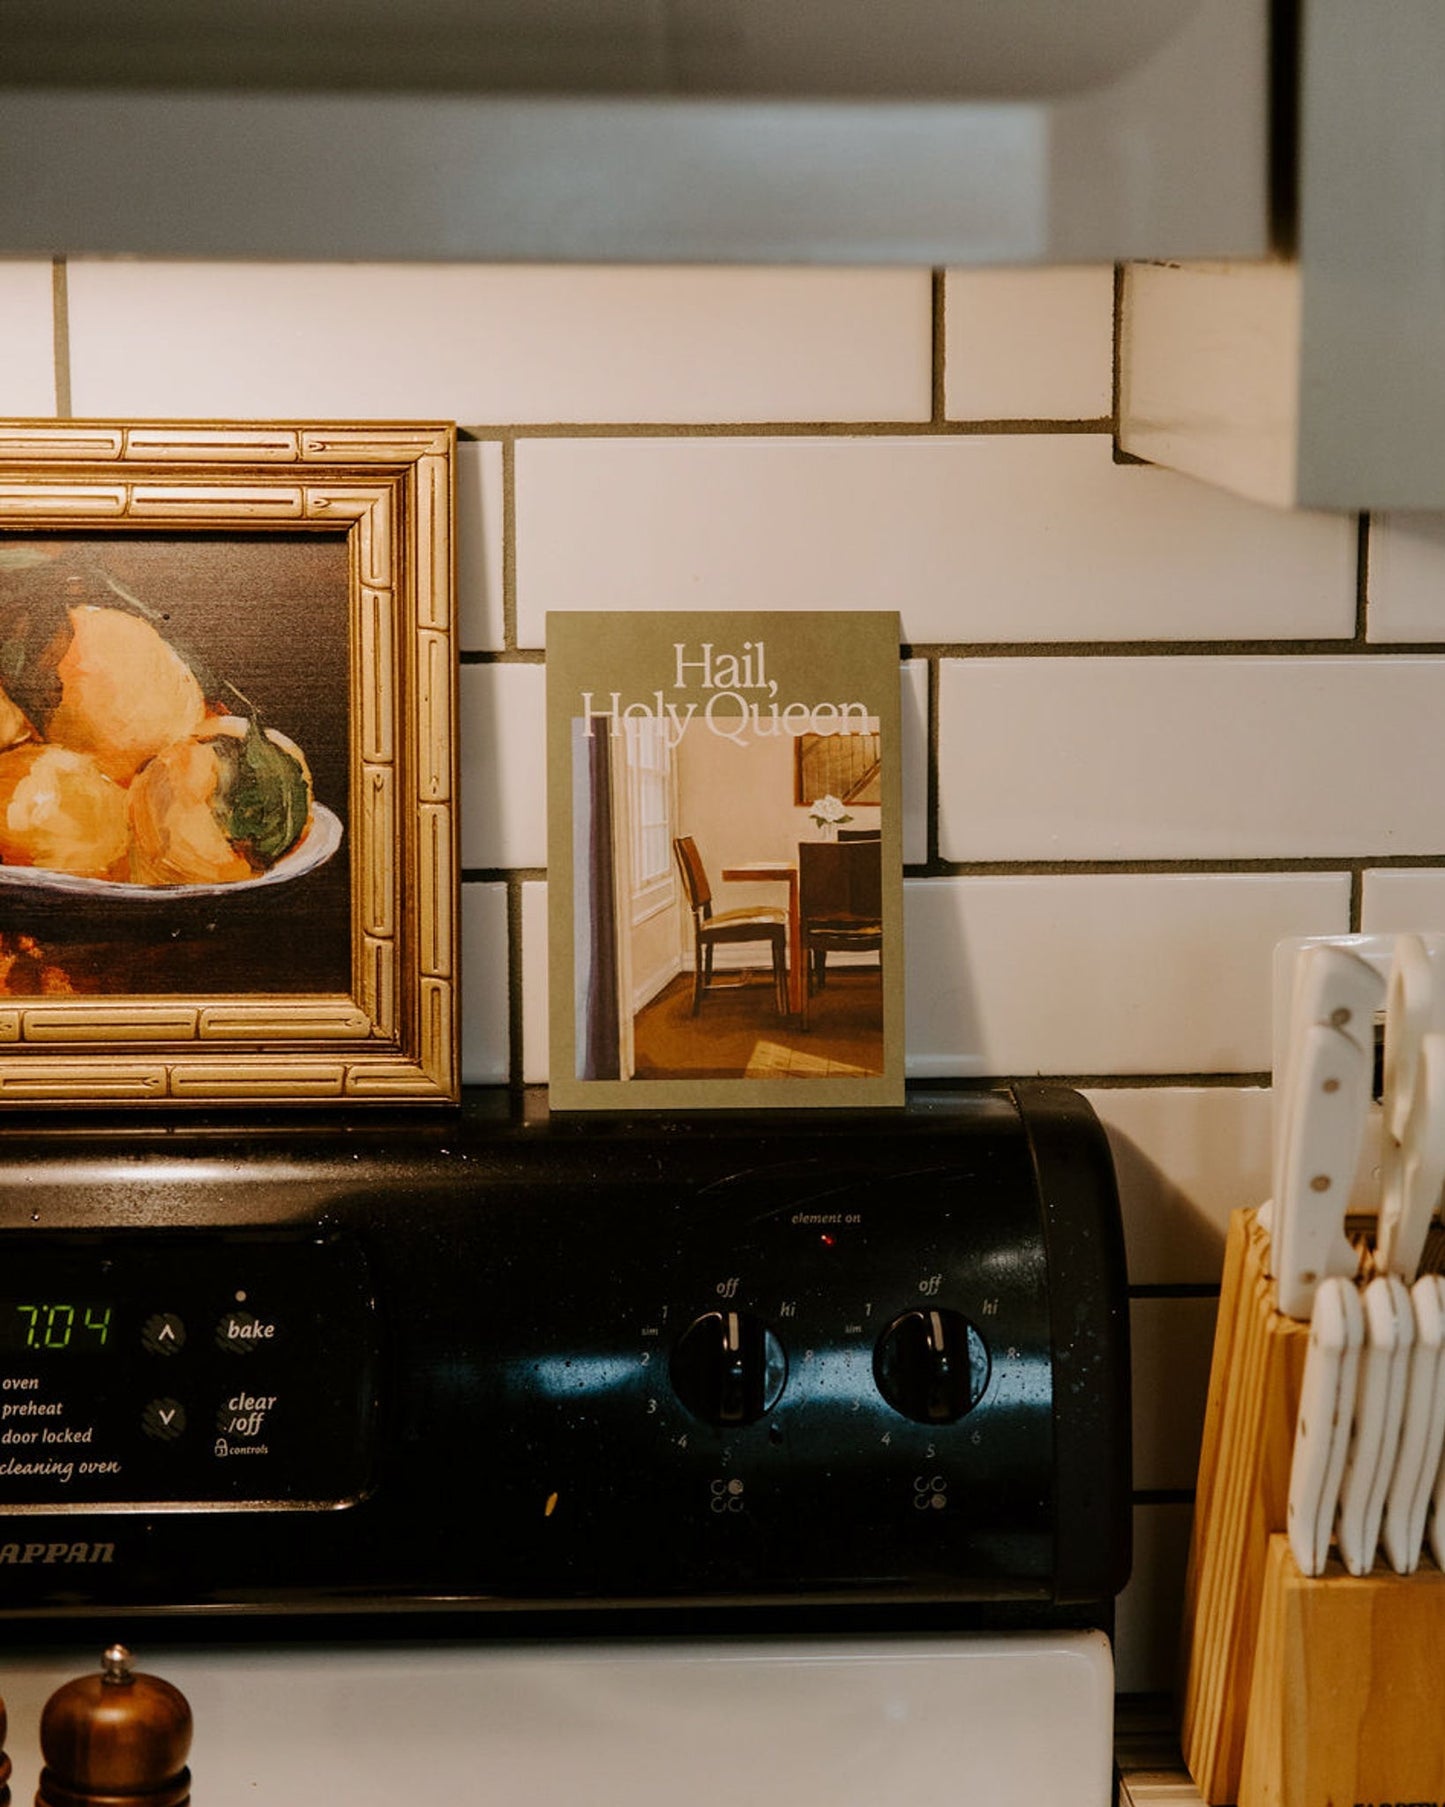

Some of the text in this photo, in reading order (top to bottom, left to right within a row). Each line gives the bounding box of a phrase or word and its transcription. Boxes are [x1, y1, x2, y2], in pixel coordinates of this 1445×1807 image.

[673, 641, 779, 698] Hail,
[580, 690, 871, 748] Holy Queen
[791, 1212, 862, 1225] element on
[715, 1277, 740, 1299] off
[918, 1274, 943, 1297] off
[661, 1305, 670, 1320] 1
[780, 1301, 797, 1318] hi
[864, 1302, 873, 1318] 1
[982, 1299, 1000, 1316] hi
[16, 1305, 112, 1349] 7:04
[227, 1320, 276, 1339] bake
[640, 1351, 651, 1367] 2
[2, 1377, 40, 1390] oven
[1, 1401, 63, 1419] preheat
[228, 1392, 278, 1411] clear
[646, 1399, 657, 1414] 3
[1, 1427, 93, 1444] door locked
[677, 1433, 689, 1449] 4
[880, 1431, 892, 1447] 4
[229, 1444, 269, 1456] controls
[925, 1443, 937, 1459] 5
[0, 1457, 122, 1483] cleaning oven
